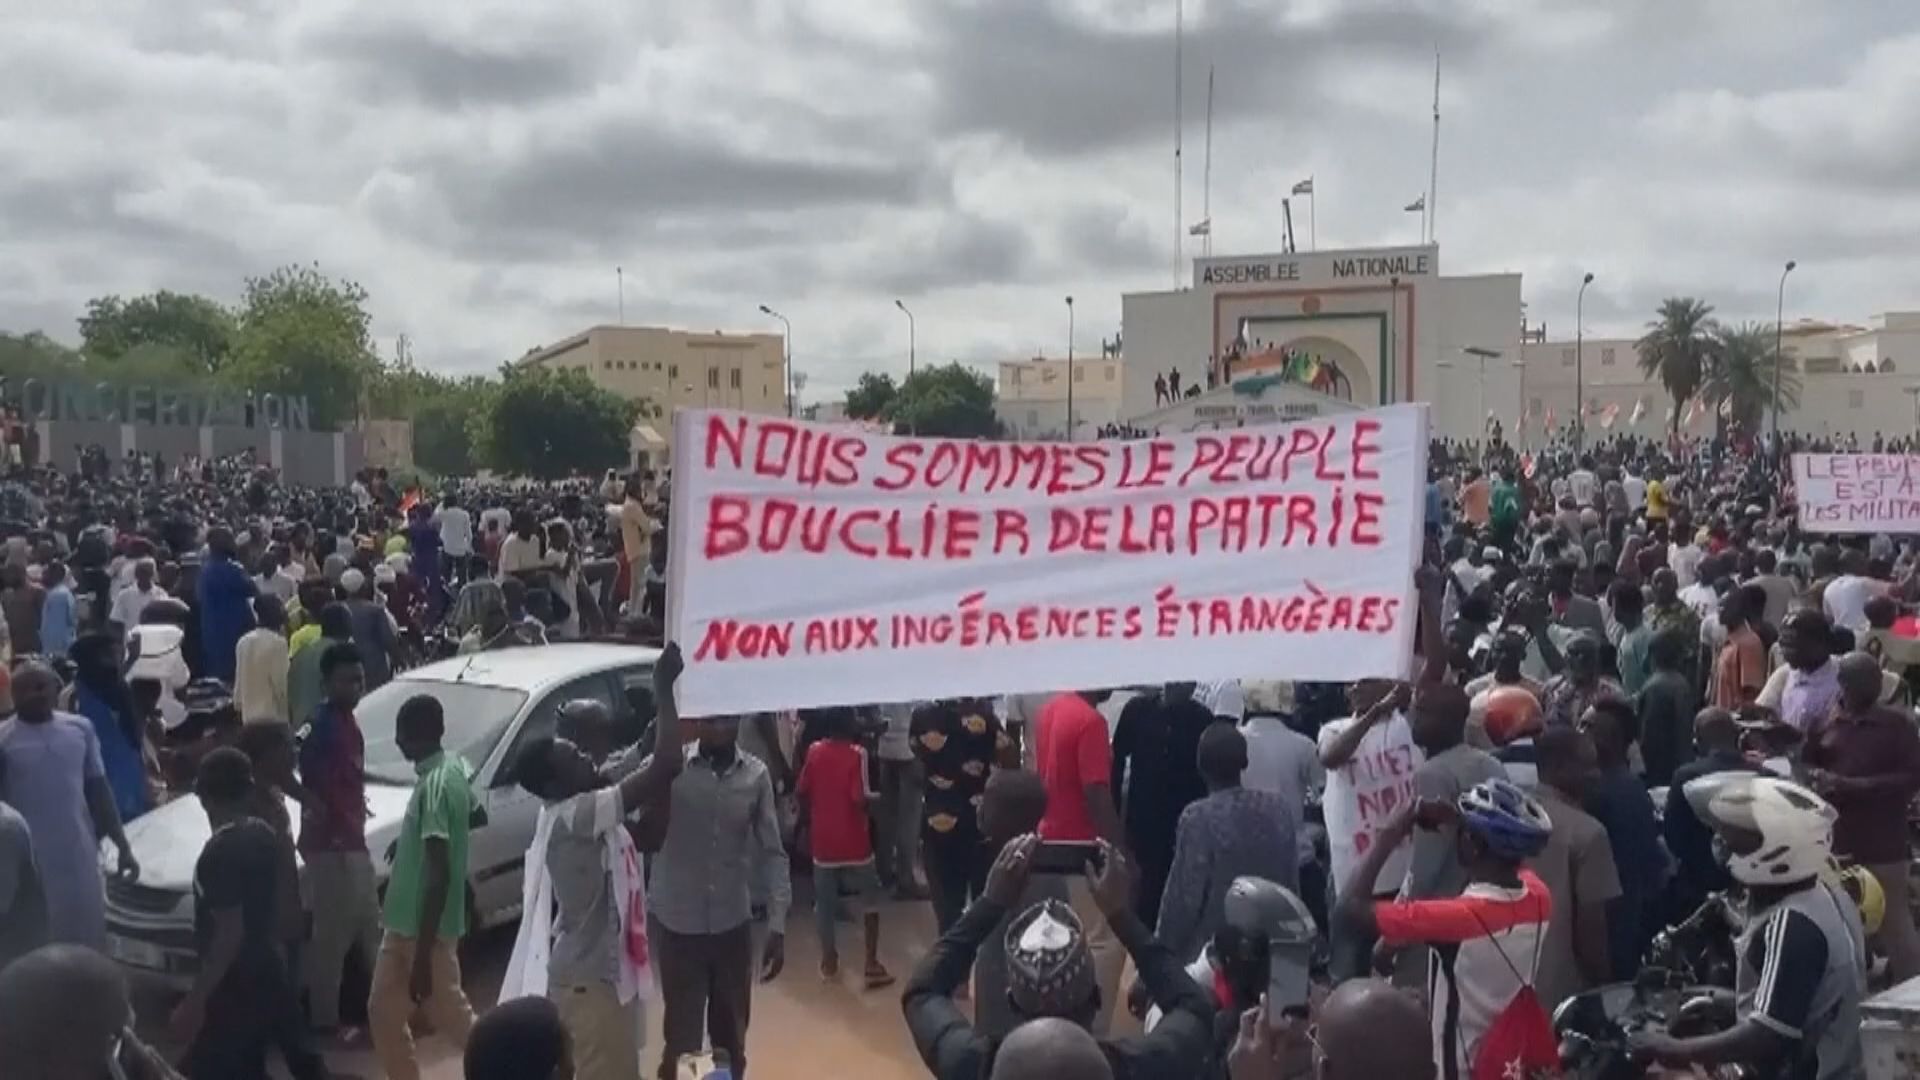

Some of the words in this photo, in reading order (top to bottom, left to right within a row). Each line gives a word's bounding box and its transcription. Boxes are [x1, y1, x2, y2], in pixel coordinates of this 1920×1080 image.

[1203, 263, 1299, 284] ASSEMBLEE
[1333, 256, 1428, 278] NATIONALE
[705, 416, 867, 487] NOUS
[873, 443, 1110, 496] SOMMES
[1116, 443, 1175, 488] LE
[1178, 420, 1382, 488] PEUPLE
[1807, 456, 1849, 479] LE
[705, 494, 1030, 559] BOUCLIER
[1048, 508, 1112, 553] DE
[1118, 504, 1176, 554] LA
[1187, 487, 1385, 556] PATRIE
[693, 620, 794, 662] NON
[804, 616, 880, 655] AUX
[891, 590, 1142, 649] INGÉRENCES
[1154, 577, 1399, 638] ÉTRANGÈRES
